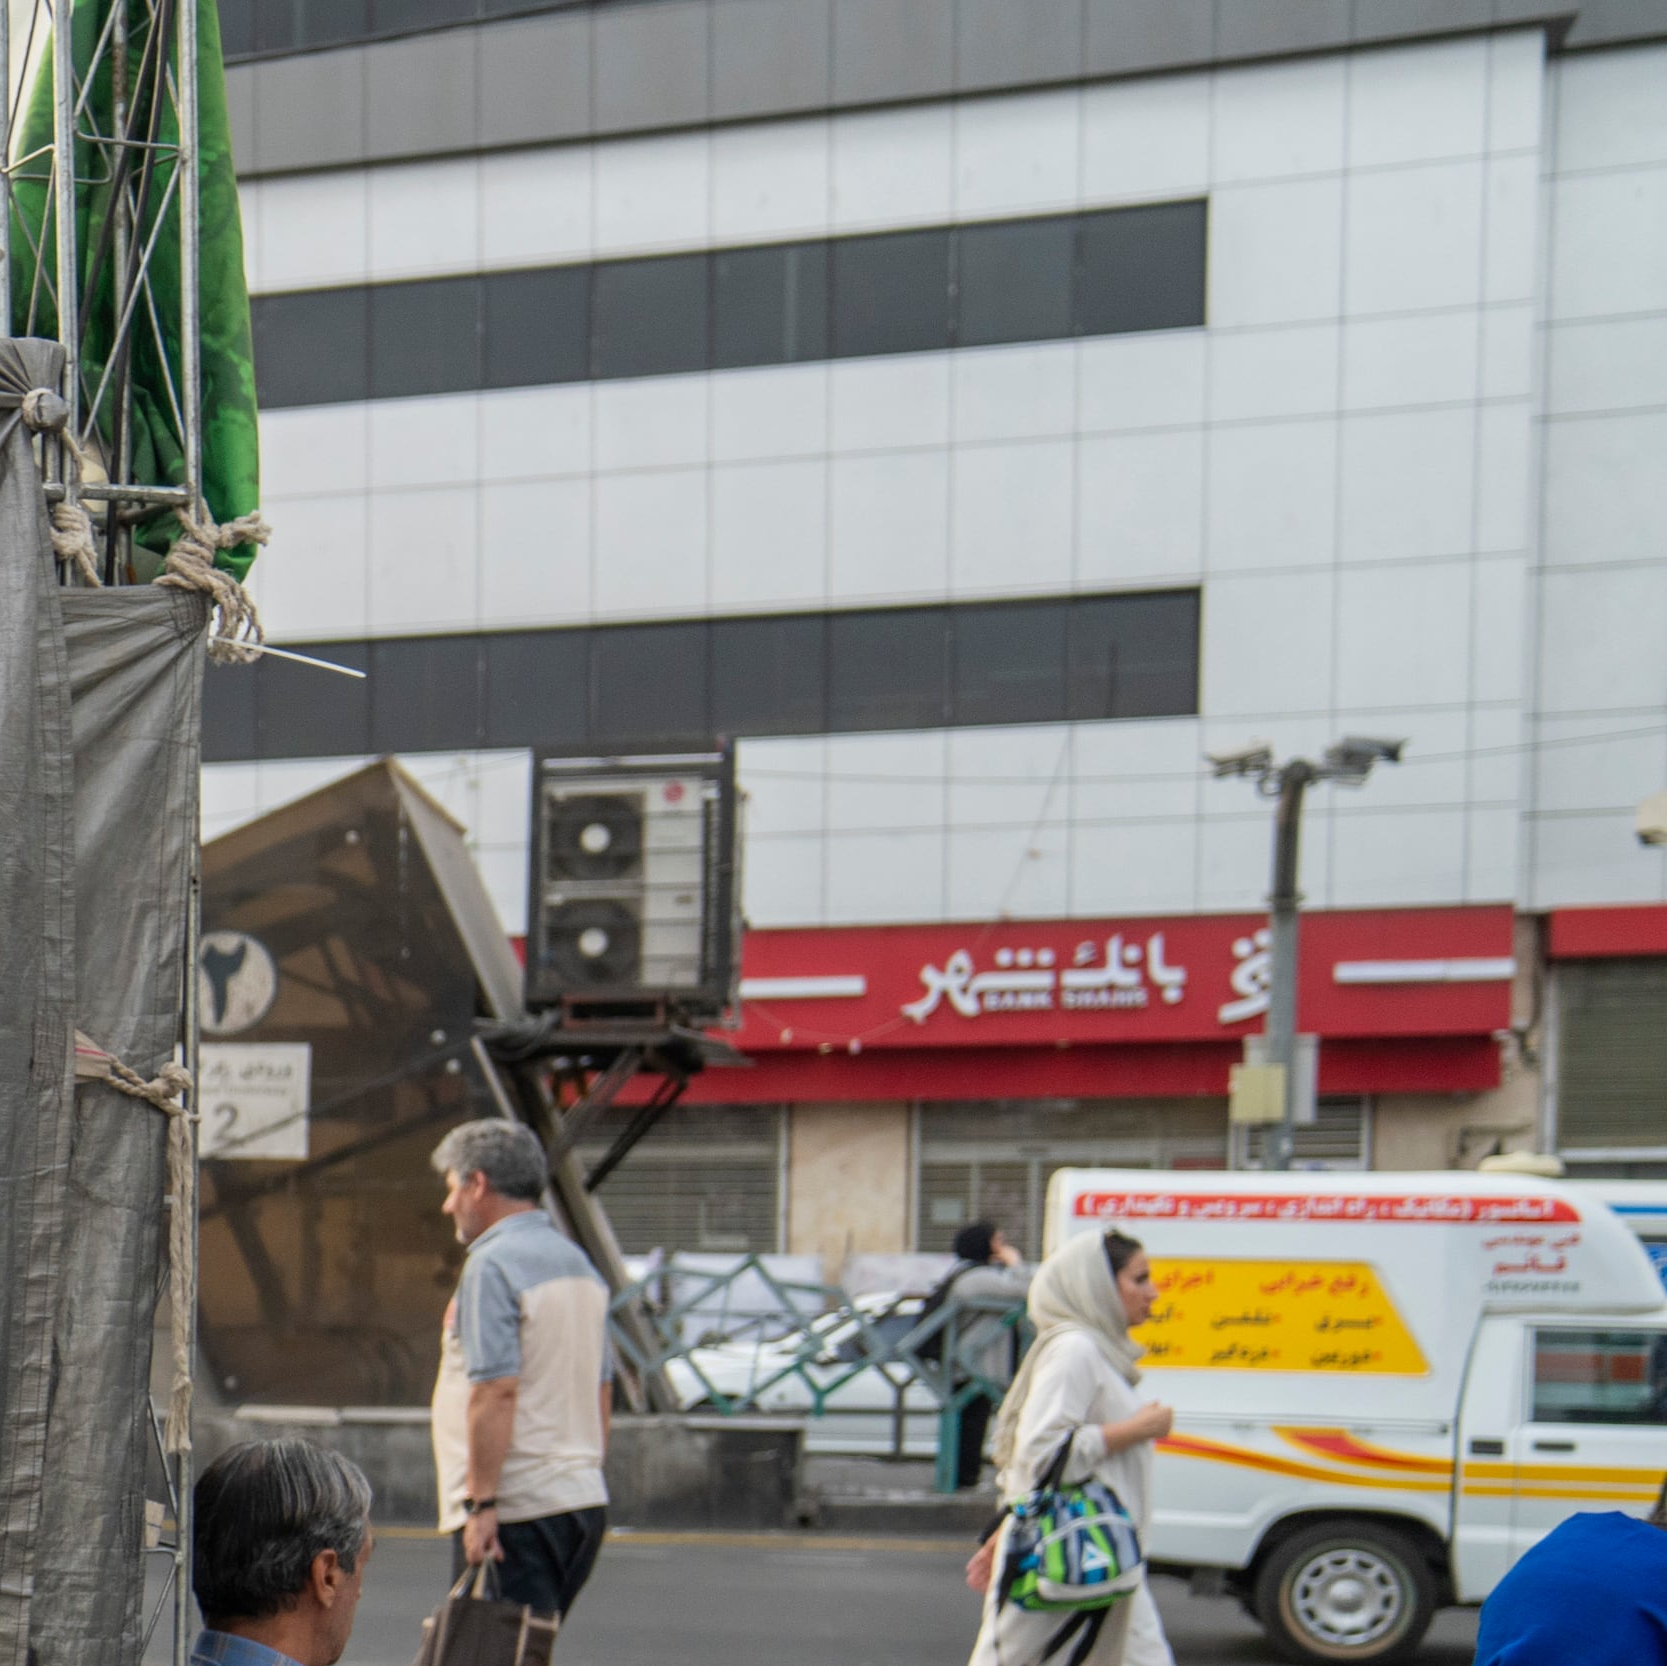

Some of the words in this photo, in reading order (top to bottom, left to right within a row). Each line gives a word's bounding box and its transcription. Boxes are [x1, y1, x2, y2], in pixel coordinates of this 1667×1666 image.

[900, 945, 1056, 1024] شهر
[1059, 930, 1187, 1006] بانک
[981, 991, 1053, 1011] BANK
[213, 1102, 239, 1142] 2
